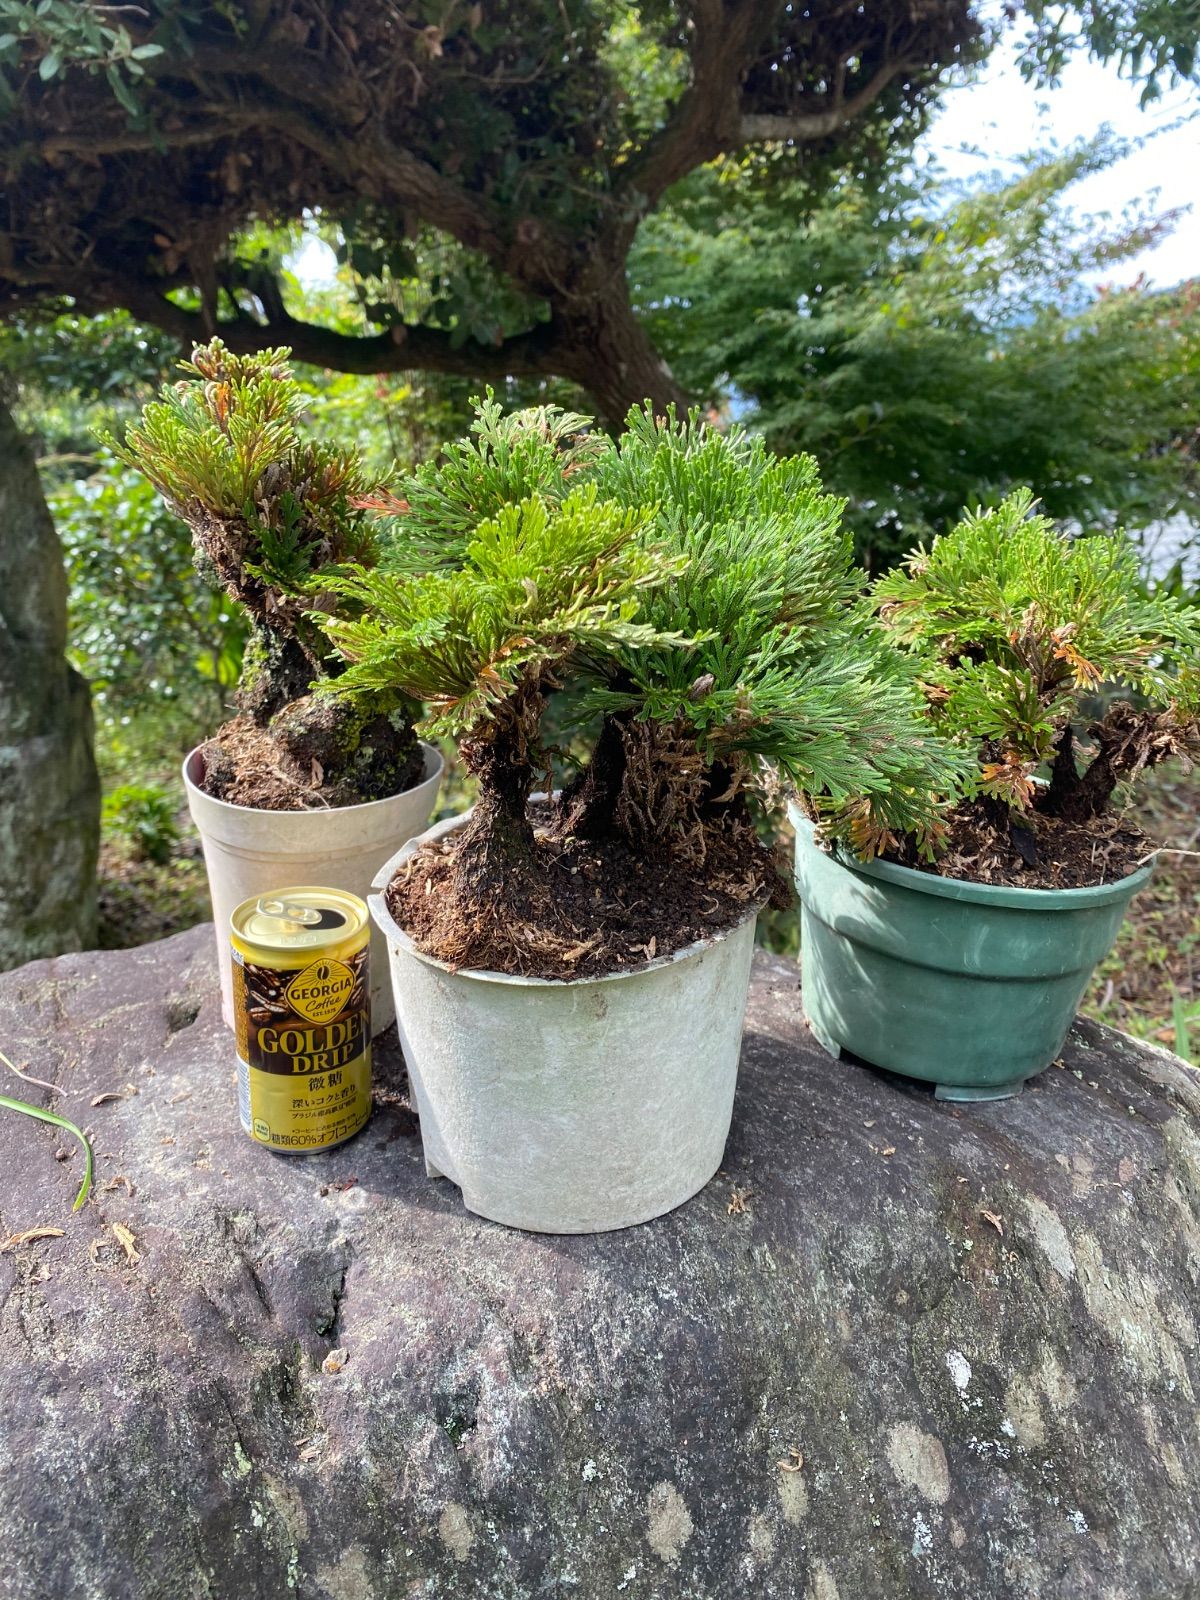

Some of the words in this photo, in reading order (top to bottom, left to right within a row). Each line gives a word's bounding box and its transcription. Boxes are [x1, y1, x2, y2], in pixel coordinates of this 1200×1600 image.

[291, 979, 351, 1000] GEORGIA
[306, 995, 341, 1012] Coffee
[292, 1043, 354, 1073] DRIP
[309, 1070, 342, 1092] 微糖
[292, 1084, 356, 1109] 深いコクと香り
